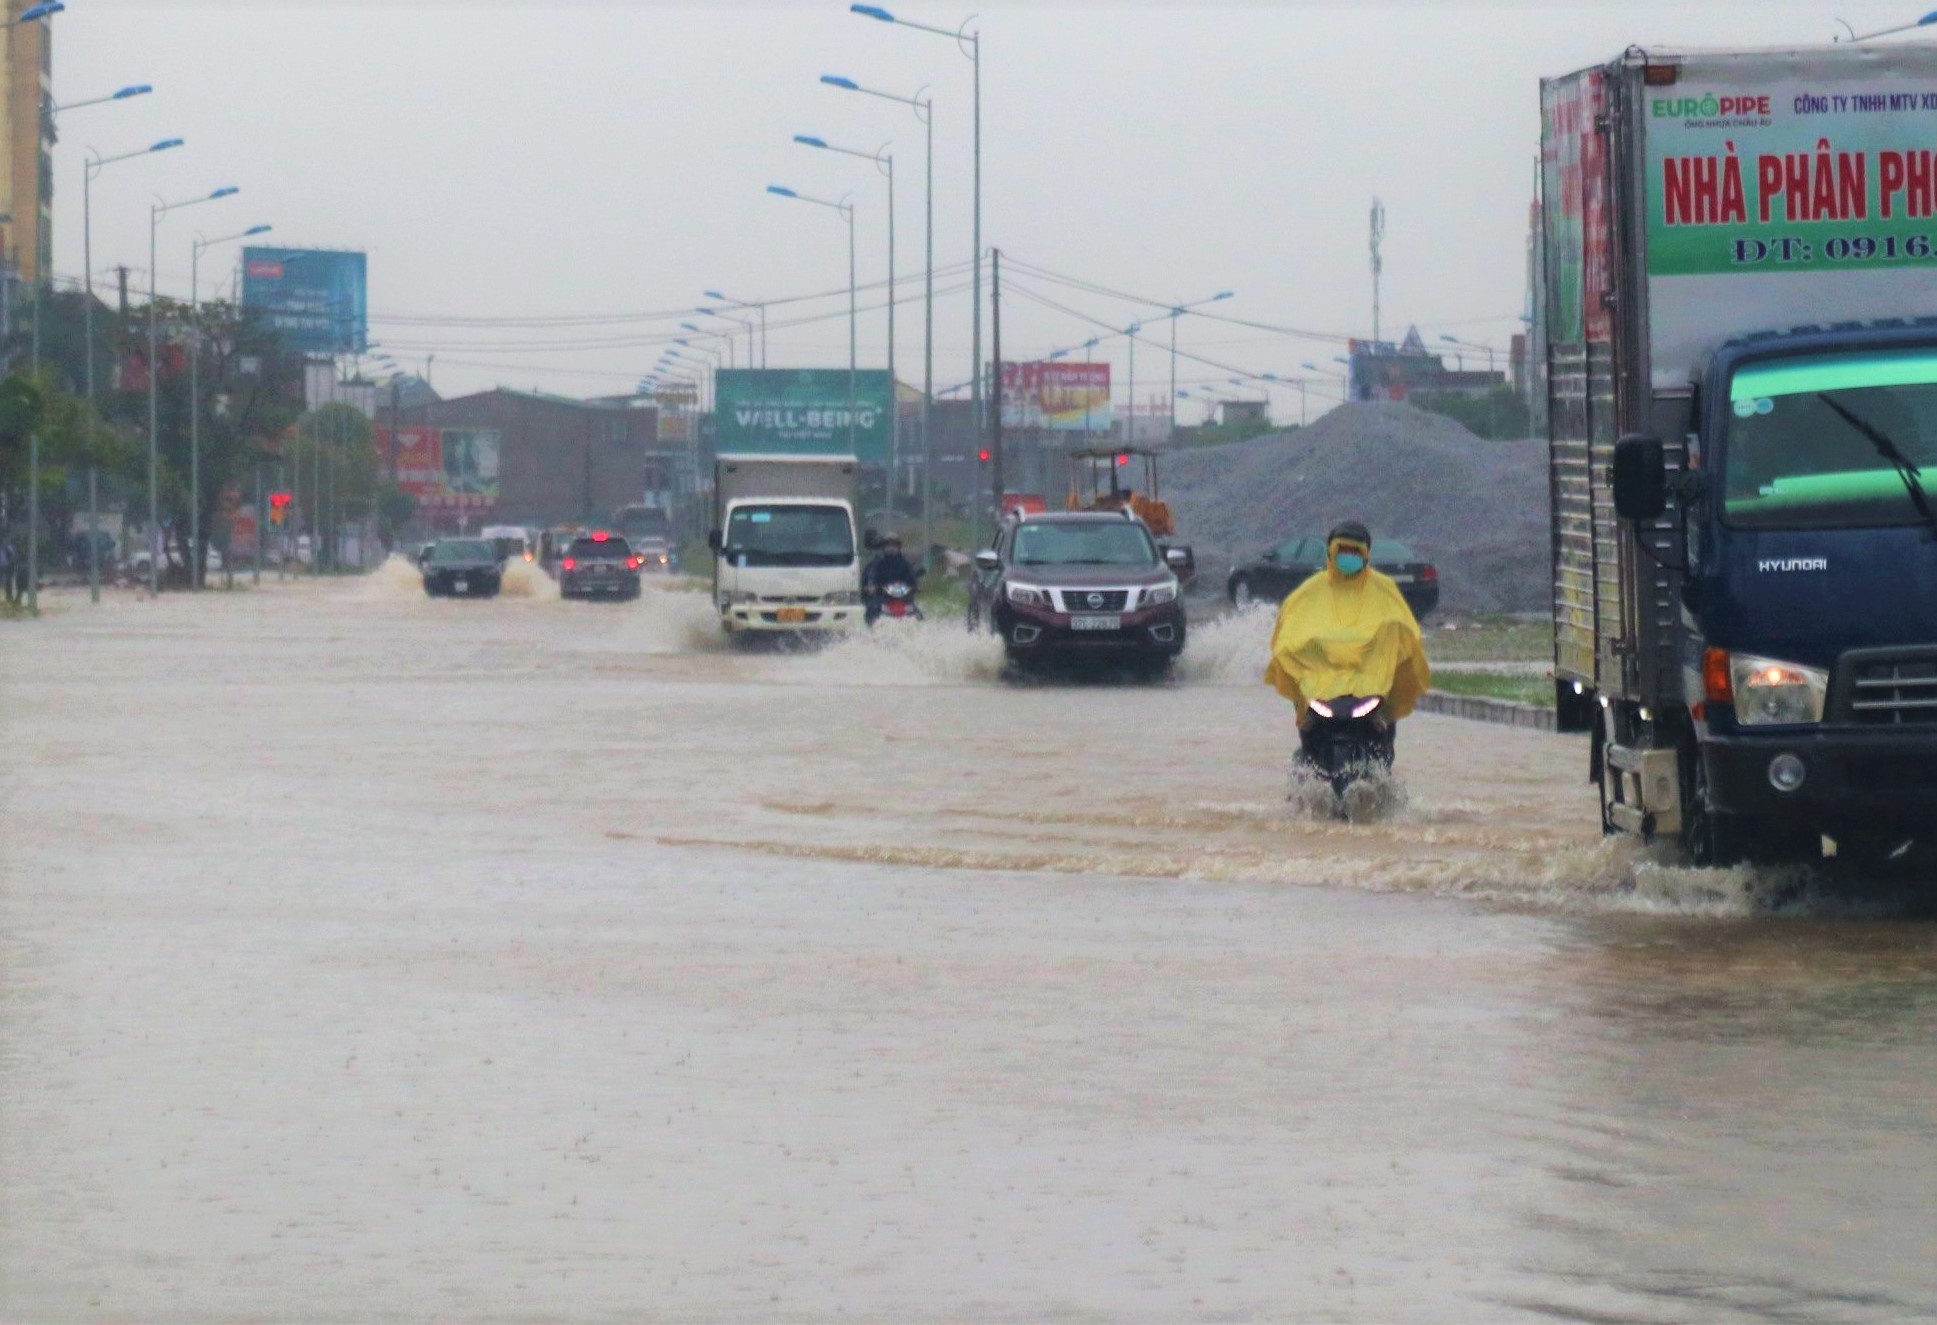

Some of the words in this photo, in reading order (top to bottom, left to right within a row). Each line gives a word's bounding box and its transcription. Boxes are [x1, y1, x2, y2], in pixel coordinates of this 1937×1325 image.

[1794, 94, 1828, 114] CÔNG
[1832, 96, 1847, 113] TY
[1851, 95, 1886, 112] TNHH
[1890, 94, 1917, 111] MTV
[1663, 140, 1747, 226] NHÀ
[1758, 138, 1867, 222] PHÂN
[1732, 237, 1813, 263] ĐT:
[1759, 558, 1827, 573] HYUNDAI
